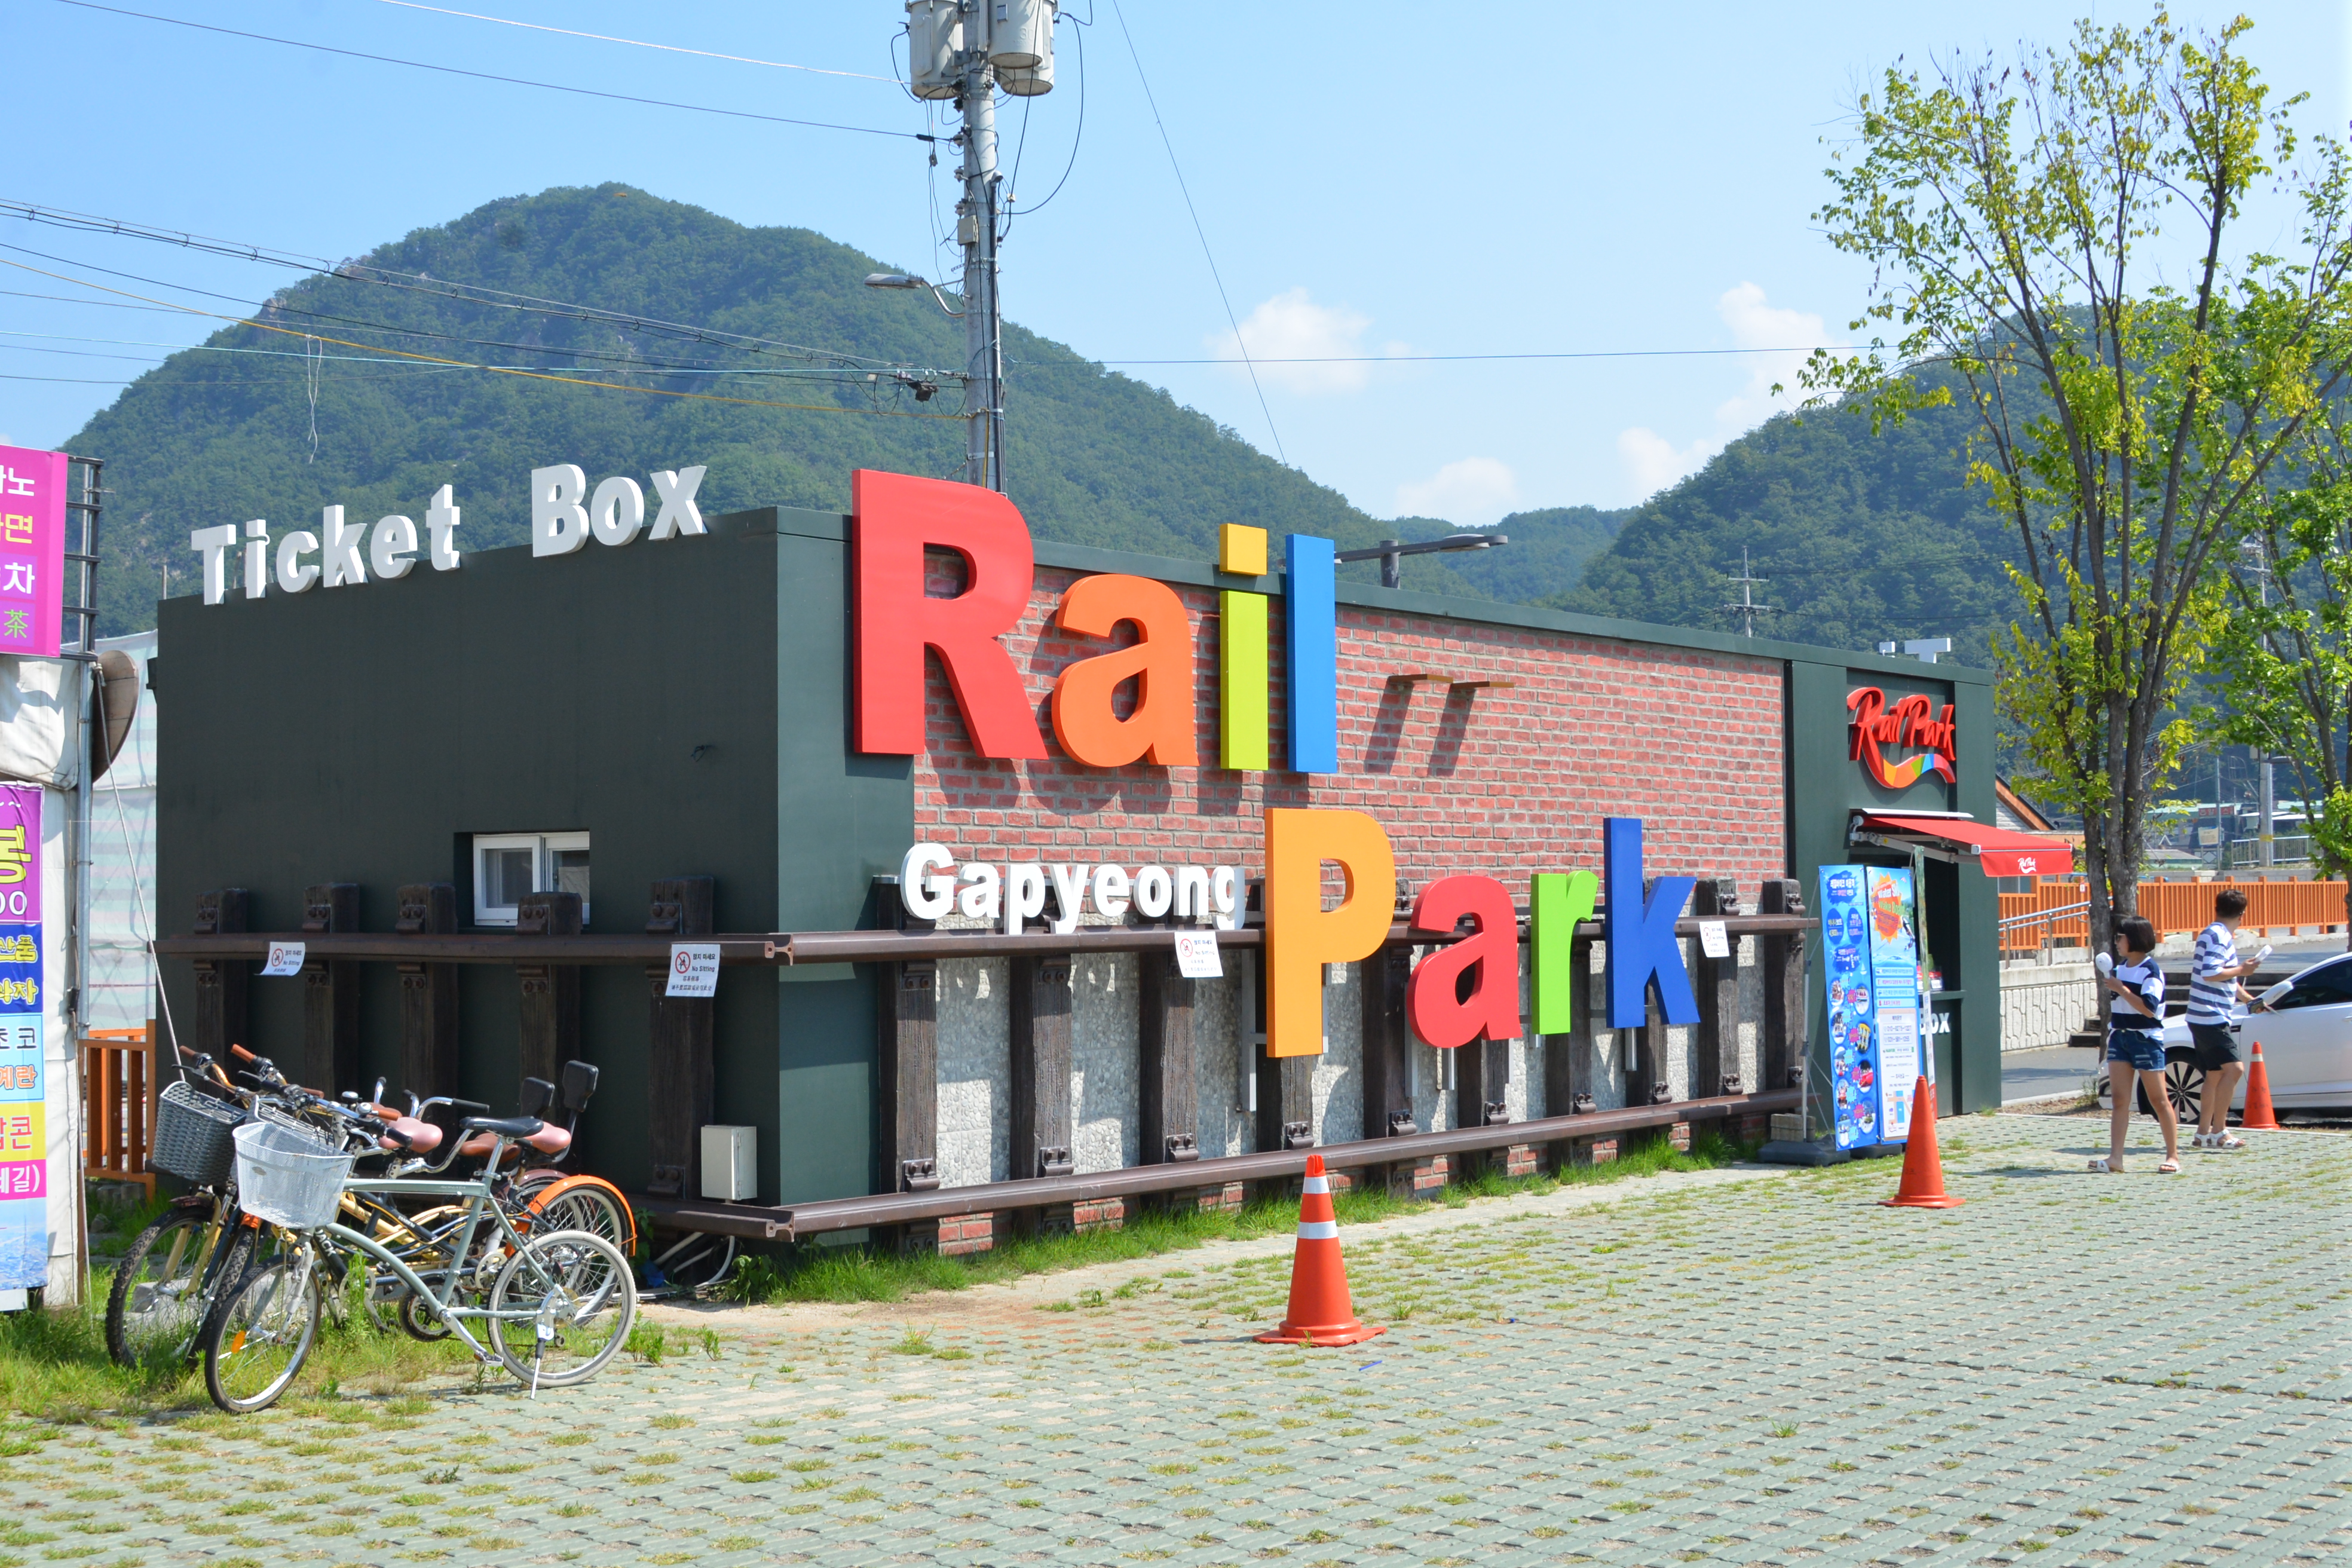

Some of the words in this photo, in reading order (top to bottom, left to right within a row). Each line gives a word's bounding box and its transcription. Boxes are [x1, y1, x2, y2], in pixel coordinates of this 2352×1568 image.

[191, 484, 460, 605] Ticket
[532, 464, 708, 558] Box
[4, 609, 29, 639] 茶
[852, 468, 1337, 773] Rail
[1900, 694, 1956, 761] Park
[901, 843, 1245, 935] Gapyeong
[1264, 807, 1701, 1058] Park
